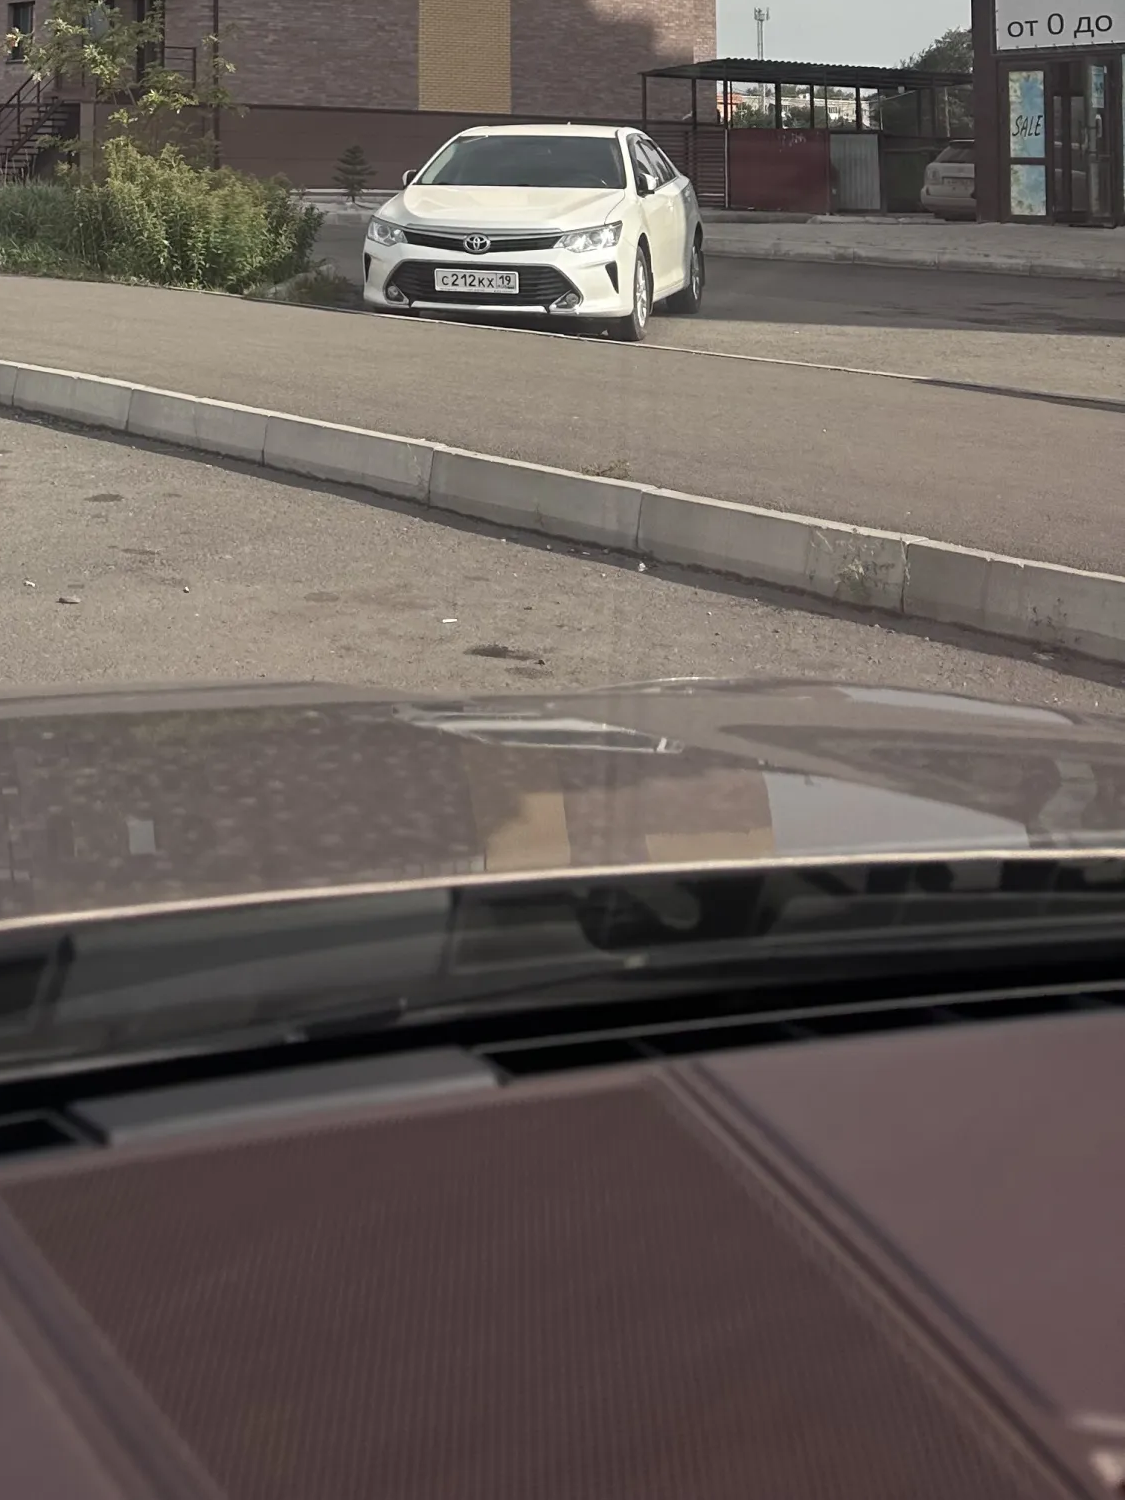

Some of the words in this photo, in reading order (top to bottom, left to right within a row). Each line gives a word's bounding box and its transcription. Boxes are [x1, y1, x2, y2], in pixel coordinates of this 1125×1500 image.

[1007, 20, 1039, 38] от
[1047, 13, 1065, 35] 0
[1074, 15, 1113, 39] до
[1012, 115, 1043, 137] SALE
[499, 275, 512, 285] 19
